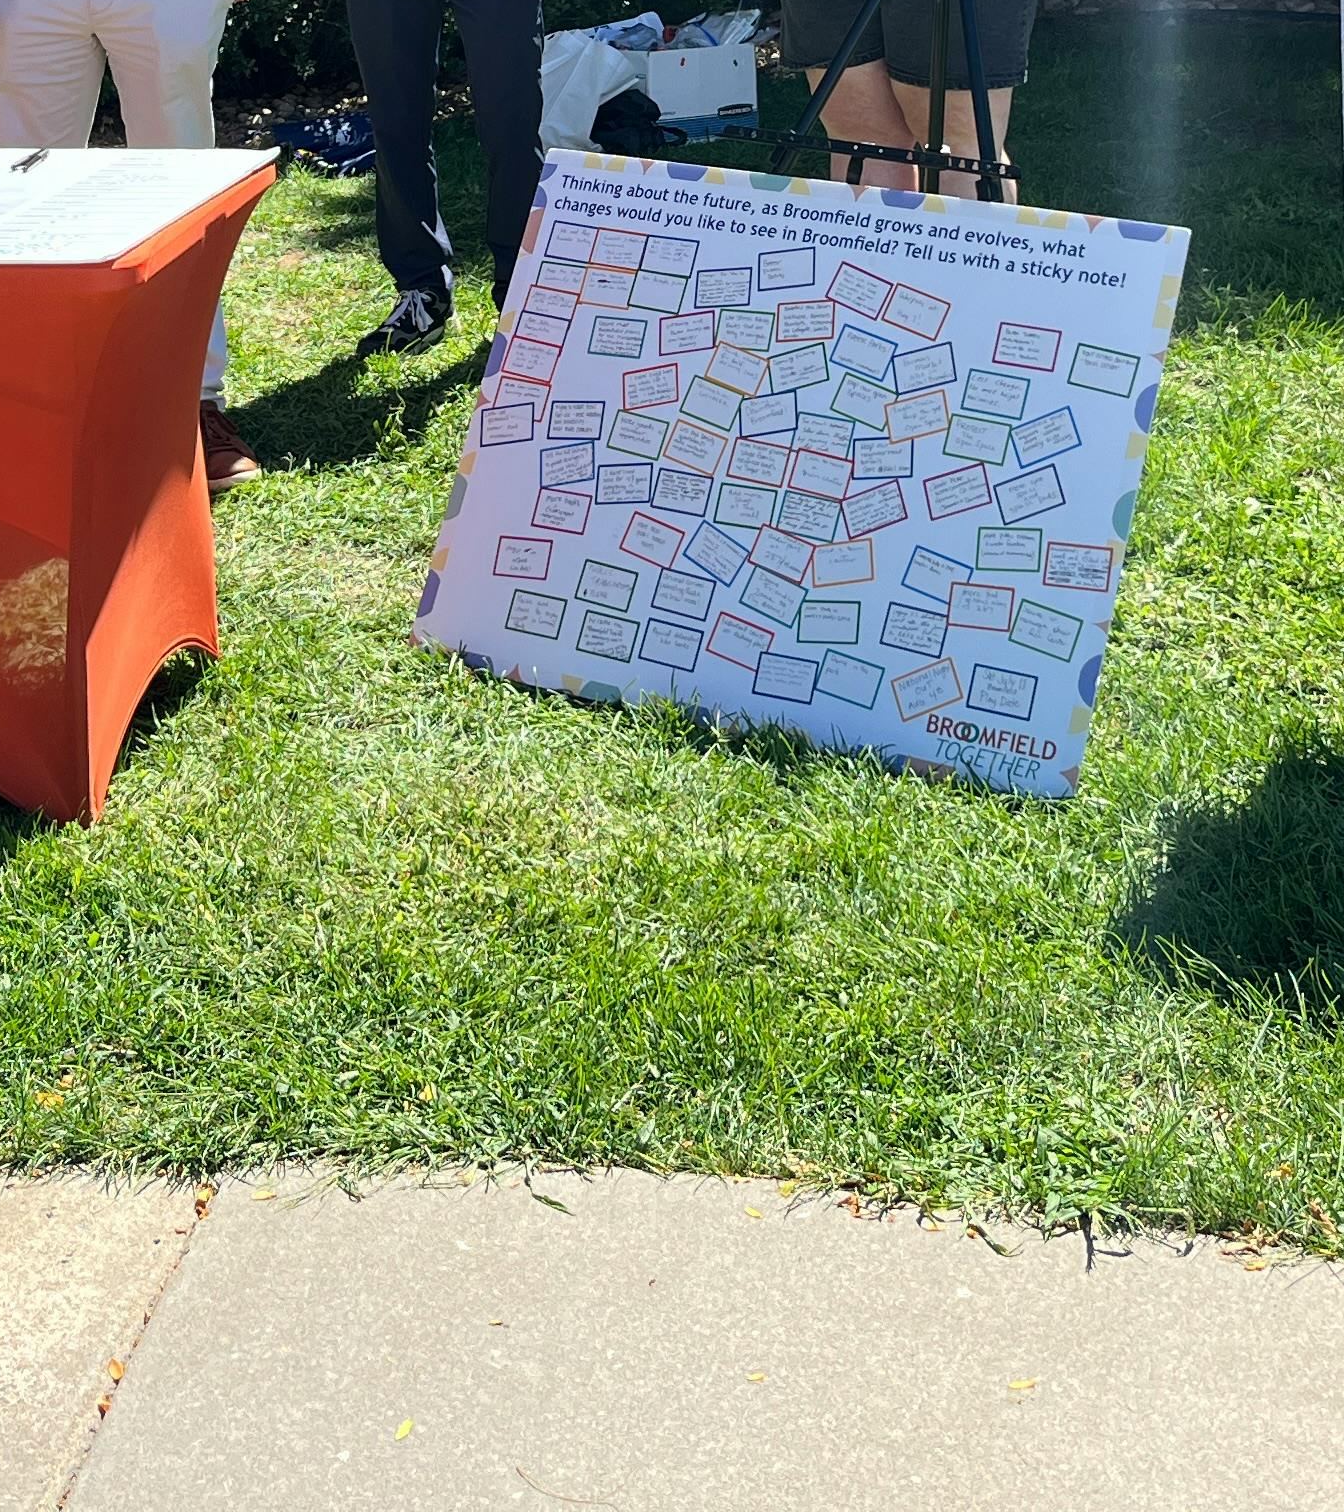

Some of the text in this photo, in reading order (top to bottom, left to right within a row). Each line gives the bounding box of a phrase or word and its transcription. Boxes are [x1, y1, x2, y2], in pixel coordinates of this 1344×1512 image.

[555, 196, 1127, 287] changes would you like to see in Broomfield? Tell us with a sticky note!
[562, 175, 1086, 258] Thinking about the future, as Broomfield grows and evolves, what
[926, 713, 1058, 761] BROOMFIELD
[935, 737, 1041, 782] TOGETHER
